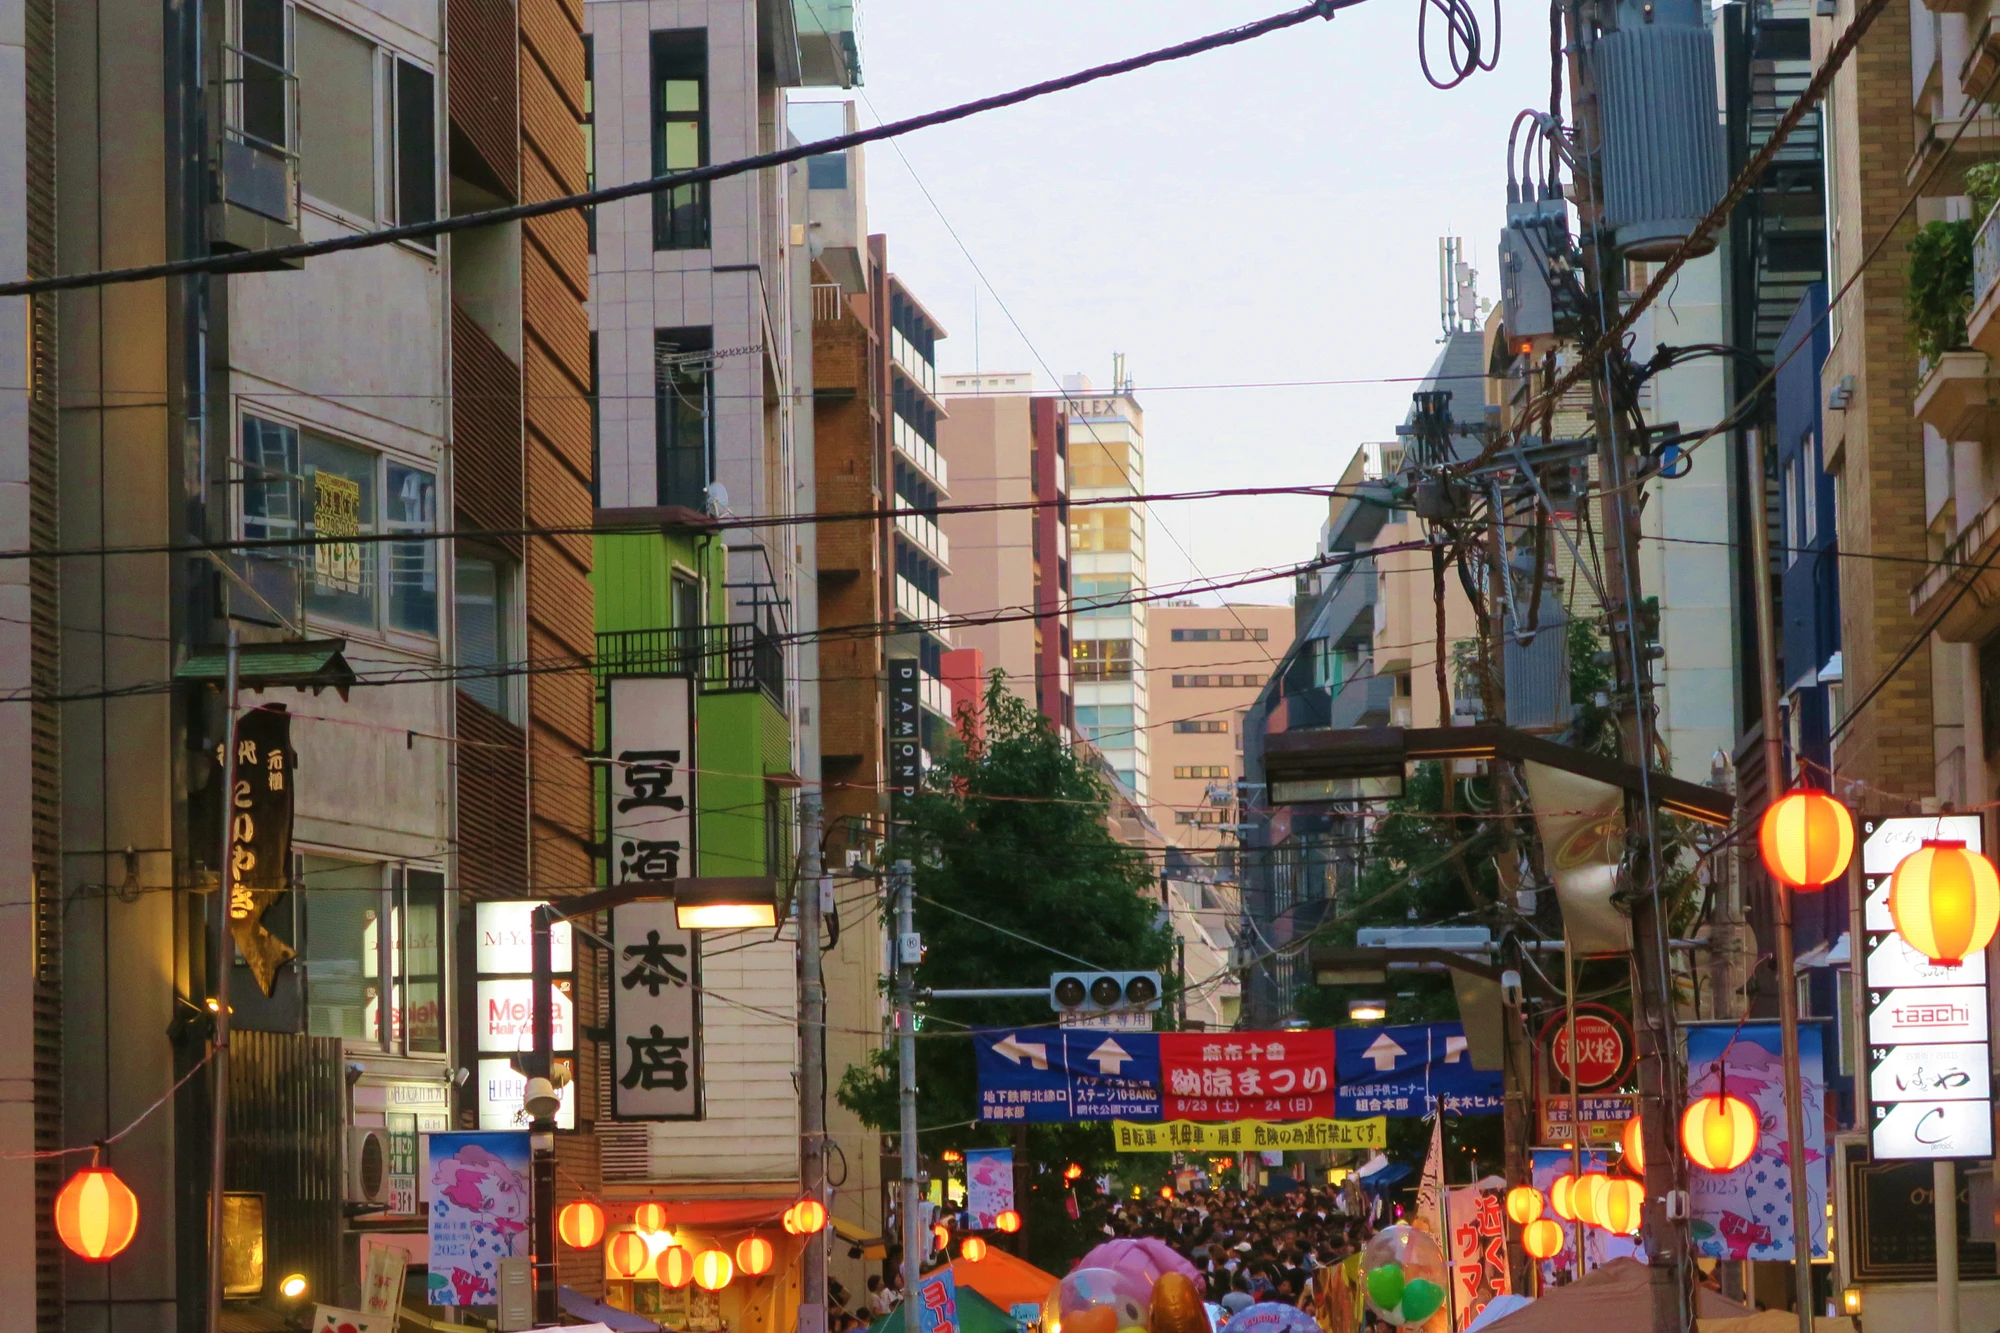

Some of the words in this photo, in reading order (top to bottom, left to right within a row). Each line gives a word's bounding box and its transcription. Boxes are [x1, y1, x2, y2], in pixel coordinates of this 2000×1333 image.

[1865, 822, 1873, 833] 6
[1867, 879, 1875, 890] 5
[1869, 936, 1877, 947] 4
[560, 982, 570, 992] 2
[1872, 992, 1880, 1004] 3
[1892, 1003, 1969, 1023] taachi
[489, 1022, 515, 1035] Hair
[1203, 1042, 1285, 1061] 麻布十番
[1172, 1067, 1327, 1096] 納涼まつり
[984, 1090, 1066, 1103] 地下鉄南北線口
[1356, 1098, 1409, 1111] 組合本部
[984, 1106, 1025, 1119] 警備本部
[1876, 1107, 1886, 1118] B
[1121, 1124, 1242, 1146] 自転車・乳母車・肩車
[1255, 1123, 1381, 1146] 危険の為通行禁止です。
[1695, 1179, 1737, 1195] 2025
[434, 1244, 465, 1256] 2025
